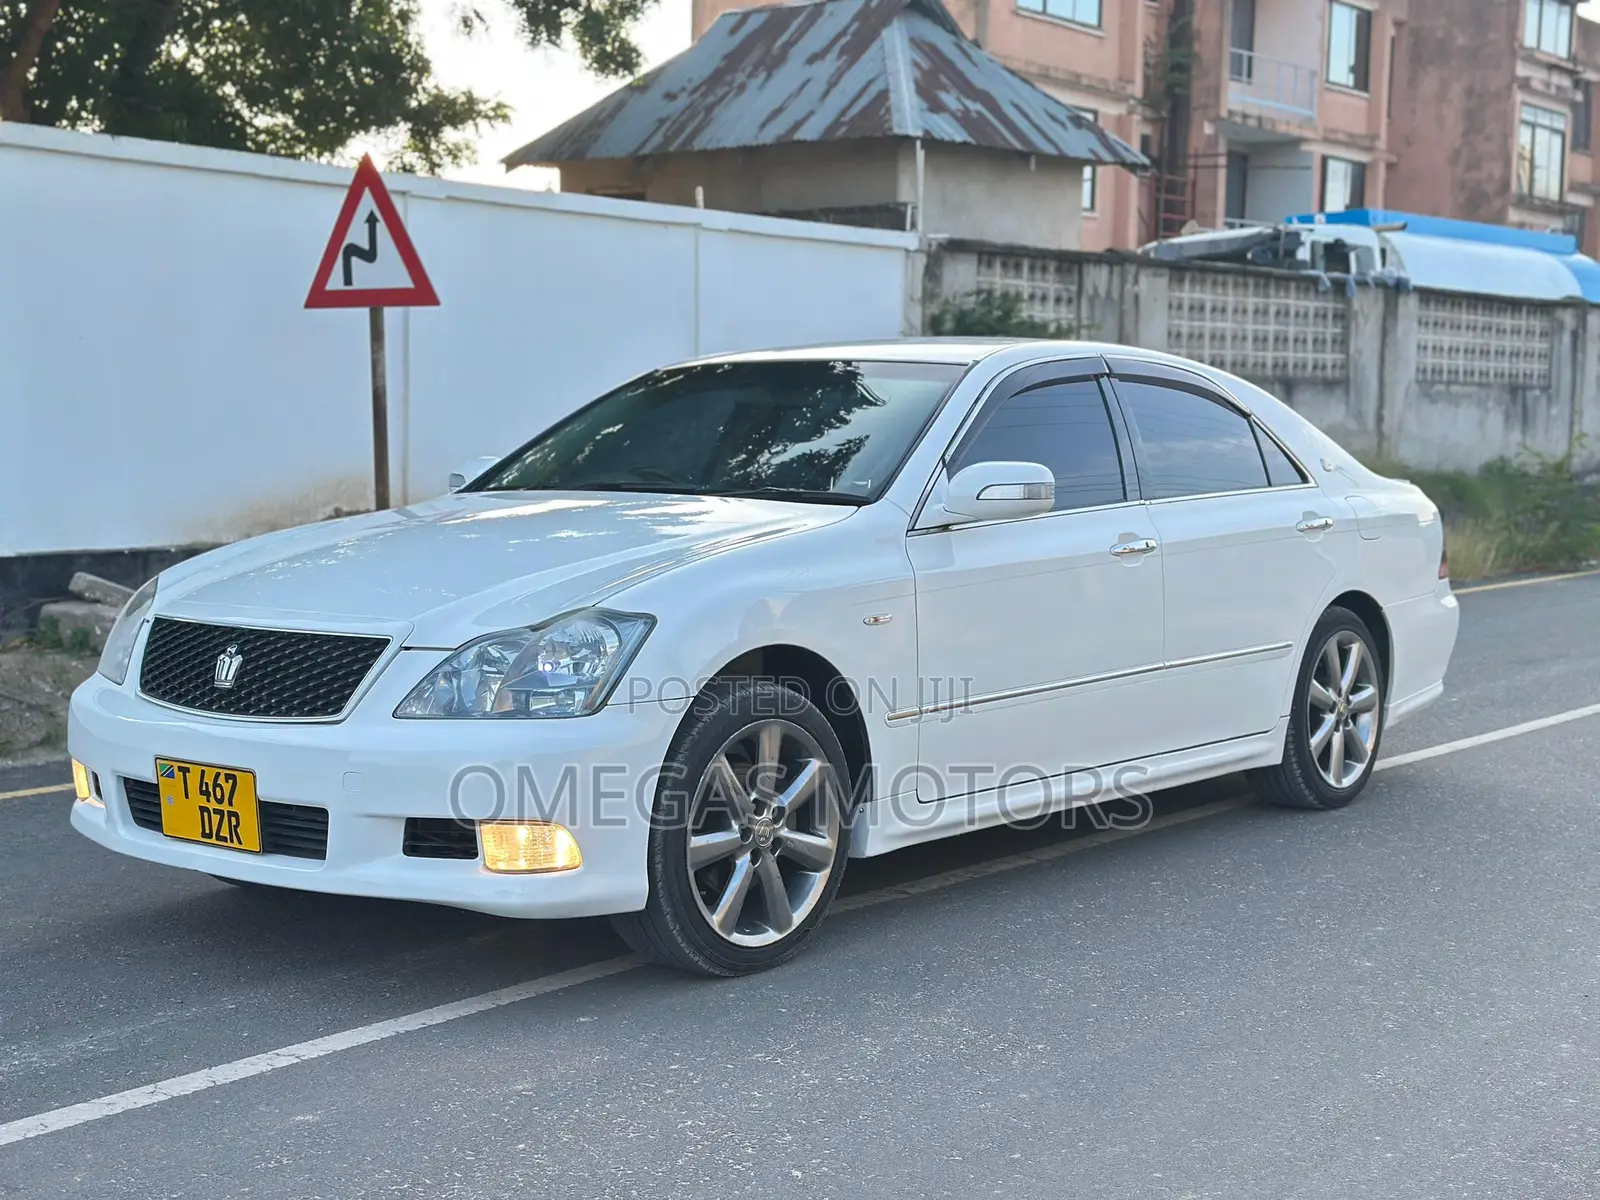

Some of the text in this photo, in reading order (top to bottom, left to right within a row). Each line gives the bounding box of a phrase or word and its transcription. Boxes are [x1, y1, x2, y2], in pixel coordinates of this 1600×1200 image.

[177, 765, 238, 807] T 467
[198, 805, 243, 845] DZR
